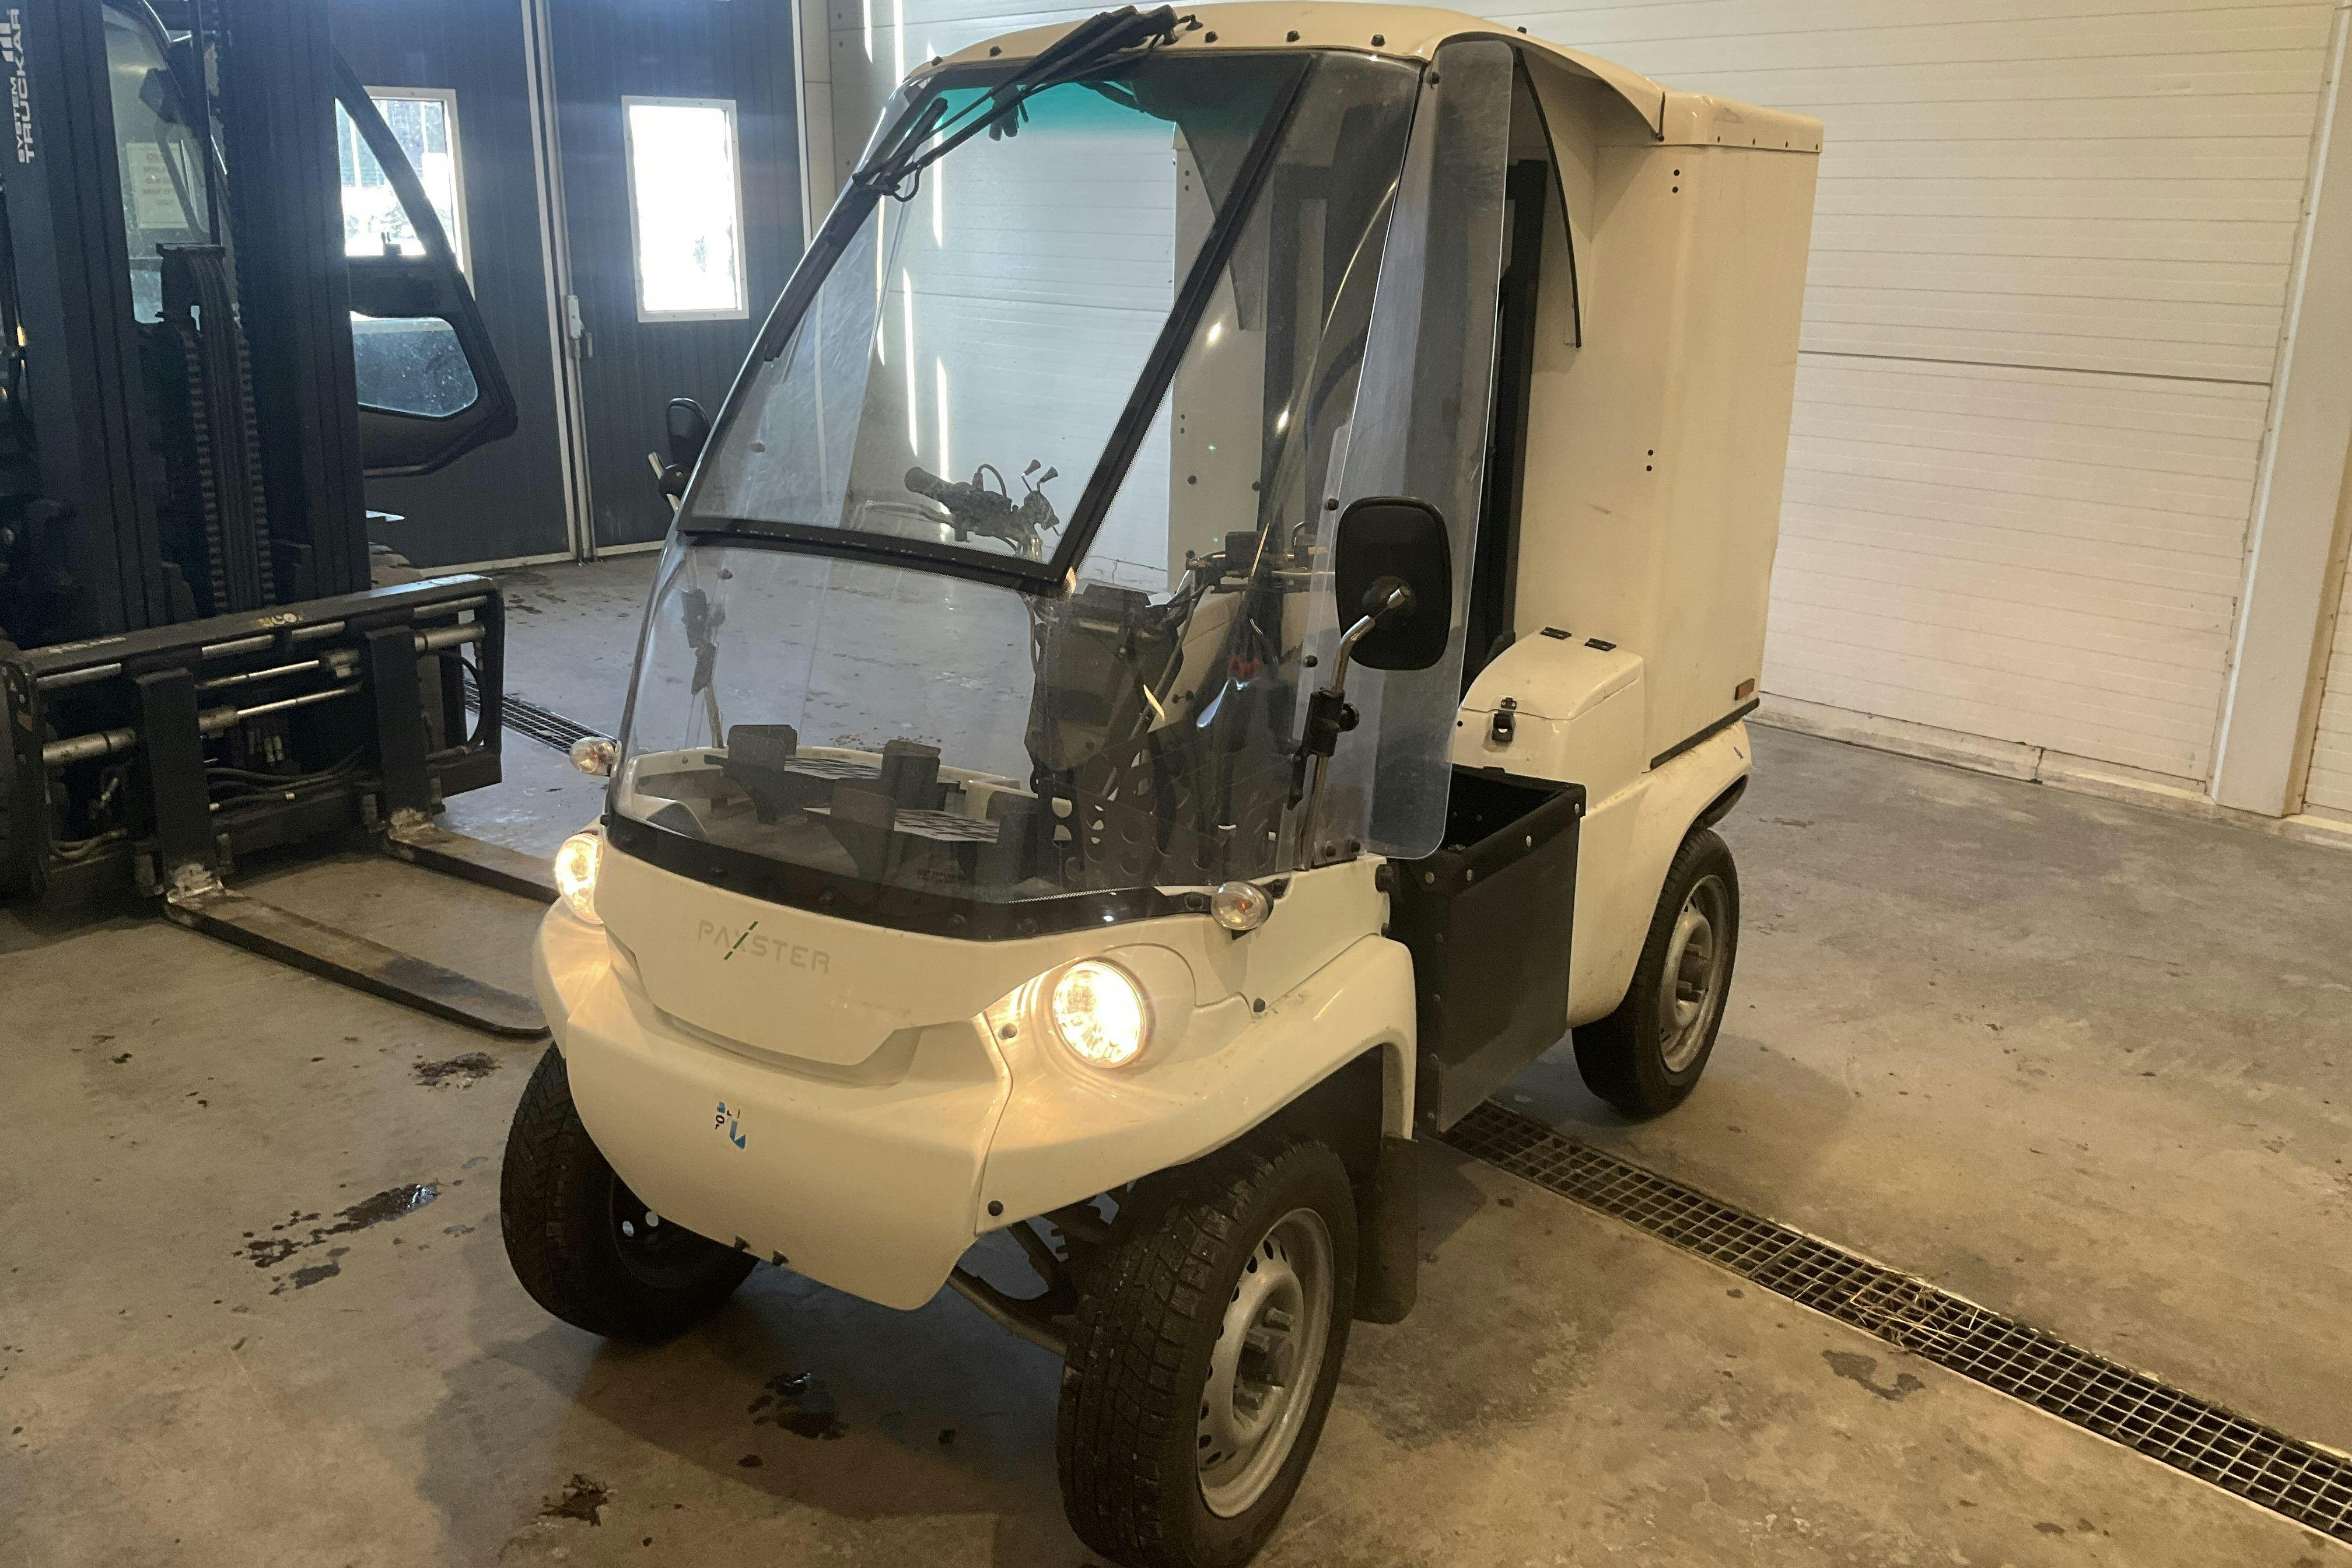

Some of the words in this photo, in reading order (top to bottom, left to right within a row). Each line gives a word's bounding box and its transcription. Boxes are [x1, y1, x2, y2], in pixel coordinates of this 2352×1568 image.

[10, 9, 34, 164] TRUCKAR
[10, 76, 25, 163] SYSTEM
[698, 920, 830, 973] PAXSTER
